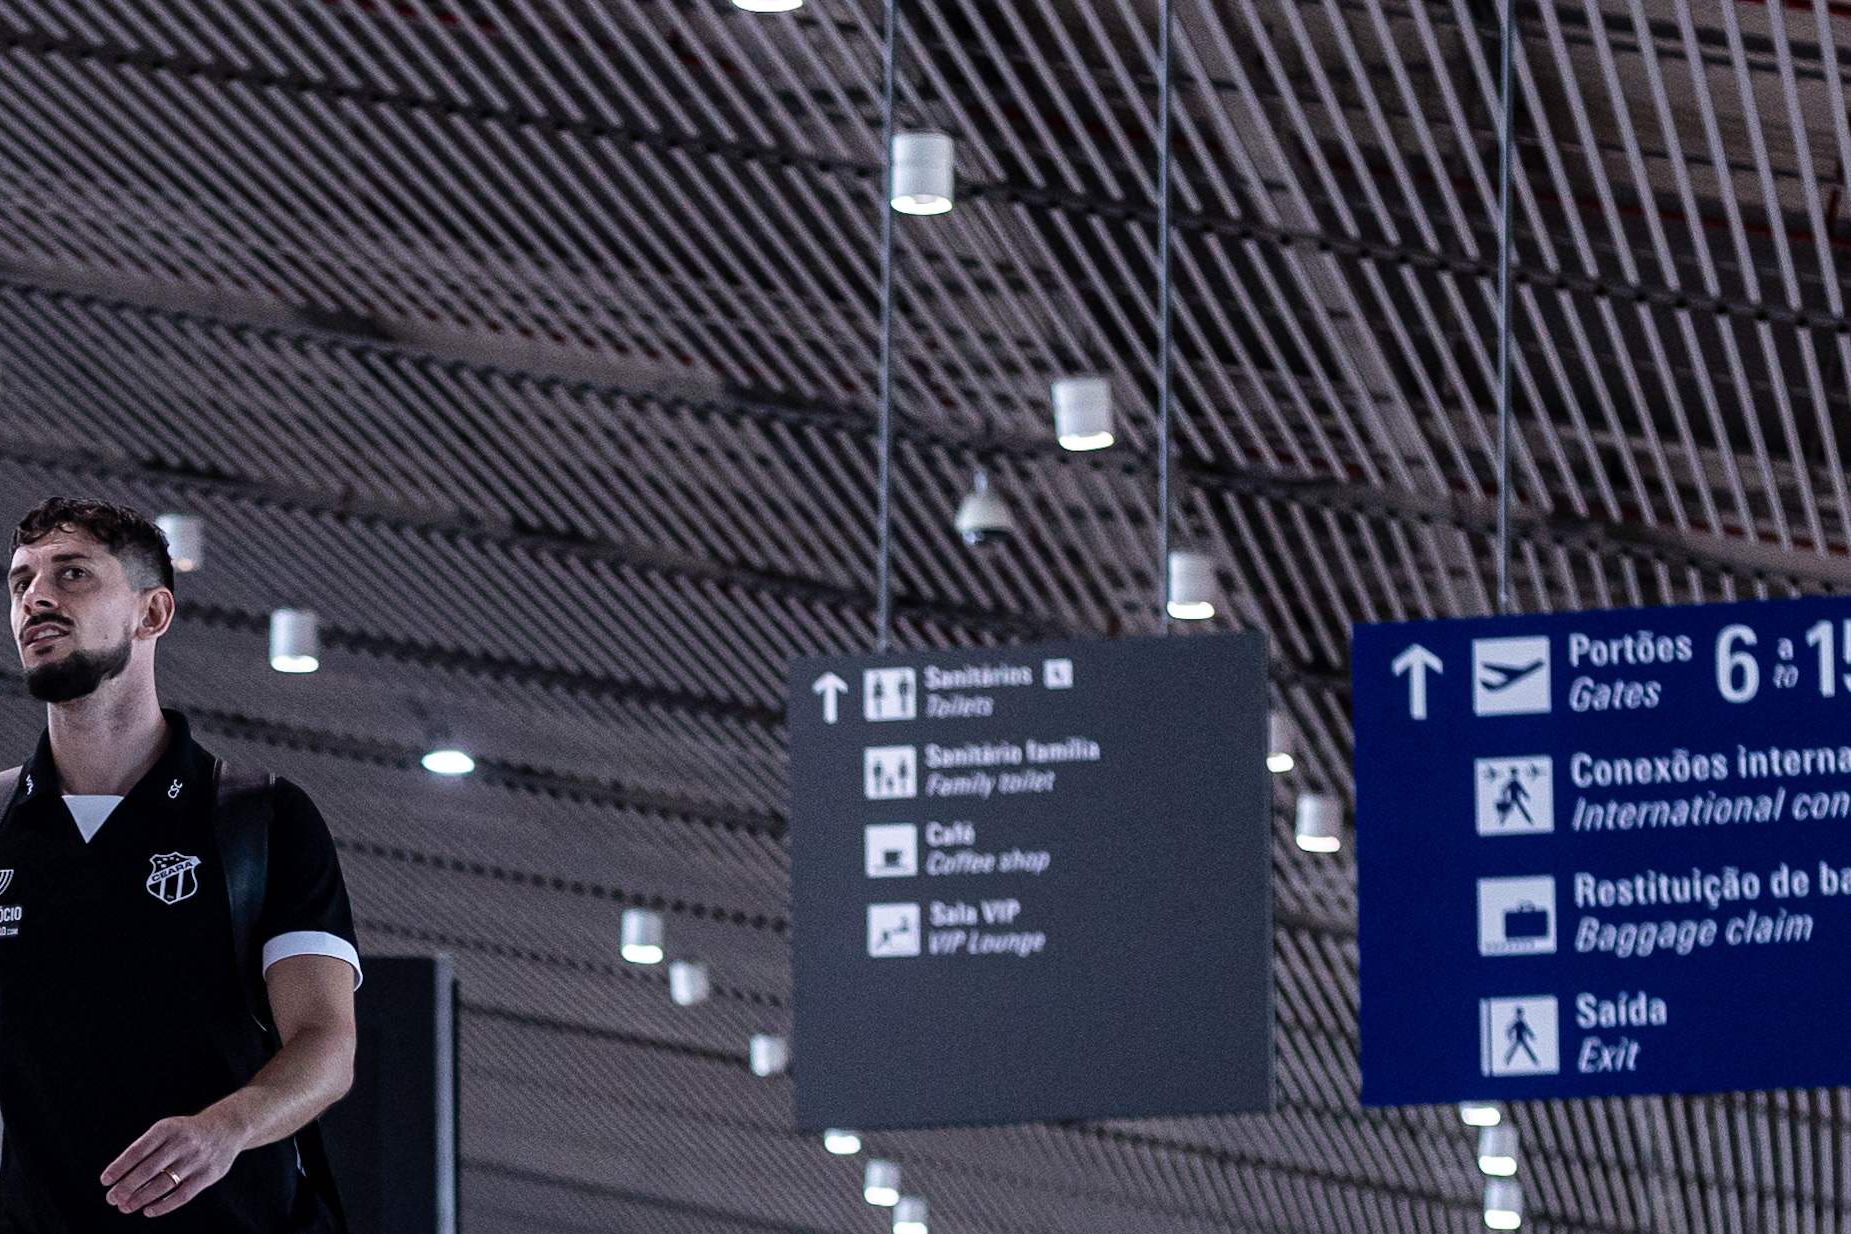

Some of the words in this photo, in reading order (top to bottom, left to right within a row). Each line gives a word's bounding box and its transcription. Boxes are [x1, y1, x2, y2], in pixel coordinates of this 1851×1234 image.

[924, 663, 1033, 690] Sanitários
[1569, 631, 1693, 667] Portões
[1716, 623, 1760, 703] 6
[1778, 637, 1794, 660] a
[1805, 618, 1851, 698] 1
[1772, 663, 1799, 688] to
[1569, 676, 1662, 712] Gates
[925, 742, 1022, 768] Sanitário
[1571, 748, 1728, 788] Conexões
[926, 772, 996, 798] Family
[998, 769, 1056, 793] toilet
[1572, 787, 1785, 831] International
[926, 821, 975, 847] Café
[926, 849, 996, 875] Coffee
[997, 847, 1050, 875] shop
[1574, 867, 1760, 910] Restituição
[1770, 862, 1809, 898] de
[930, 900, 978, 926] Sala
[981, 898, 1021, 924] VIP
[929, 929, 966, 956] VIP
[967, 930, 1046, 958] Lounge
[1574, 915, 1718, 959] Baggage
[1725, 907, 1813, 945] claim
[1576, 991, 1667, 1028] Saída
[1577, 1036, 1641, 1074] Exit
